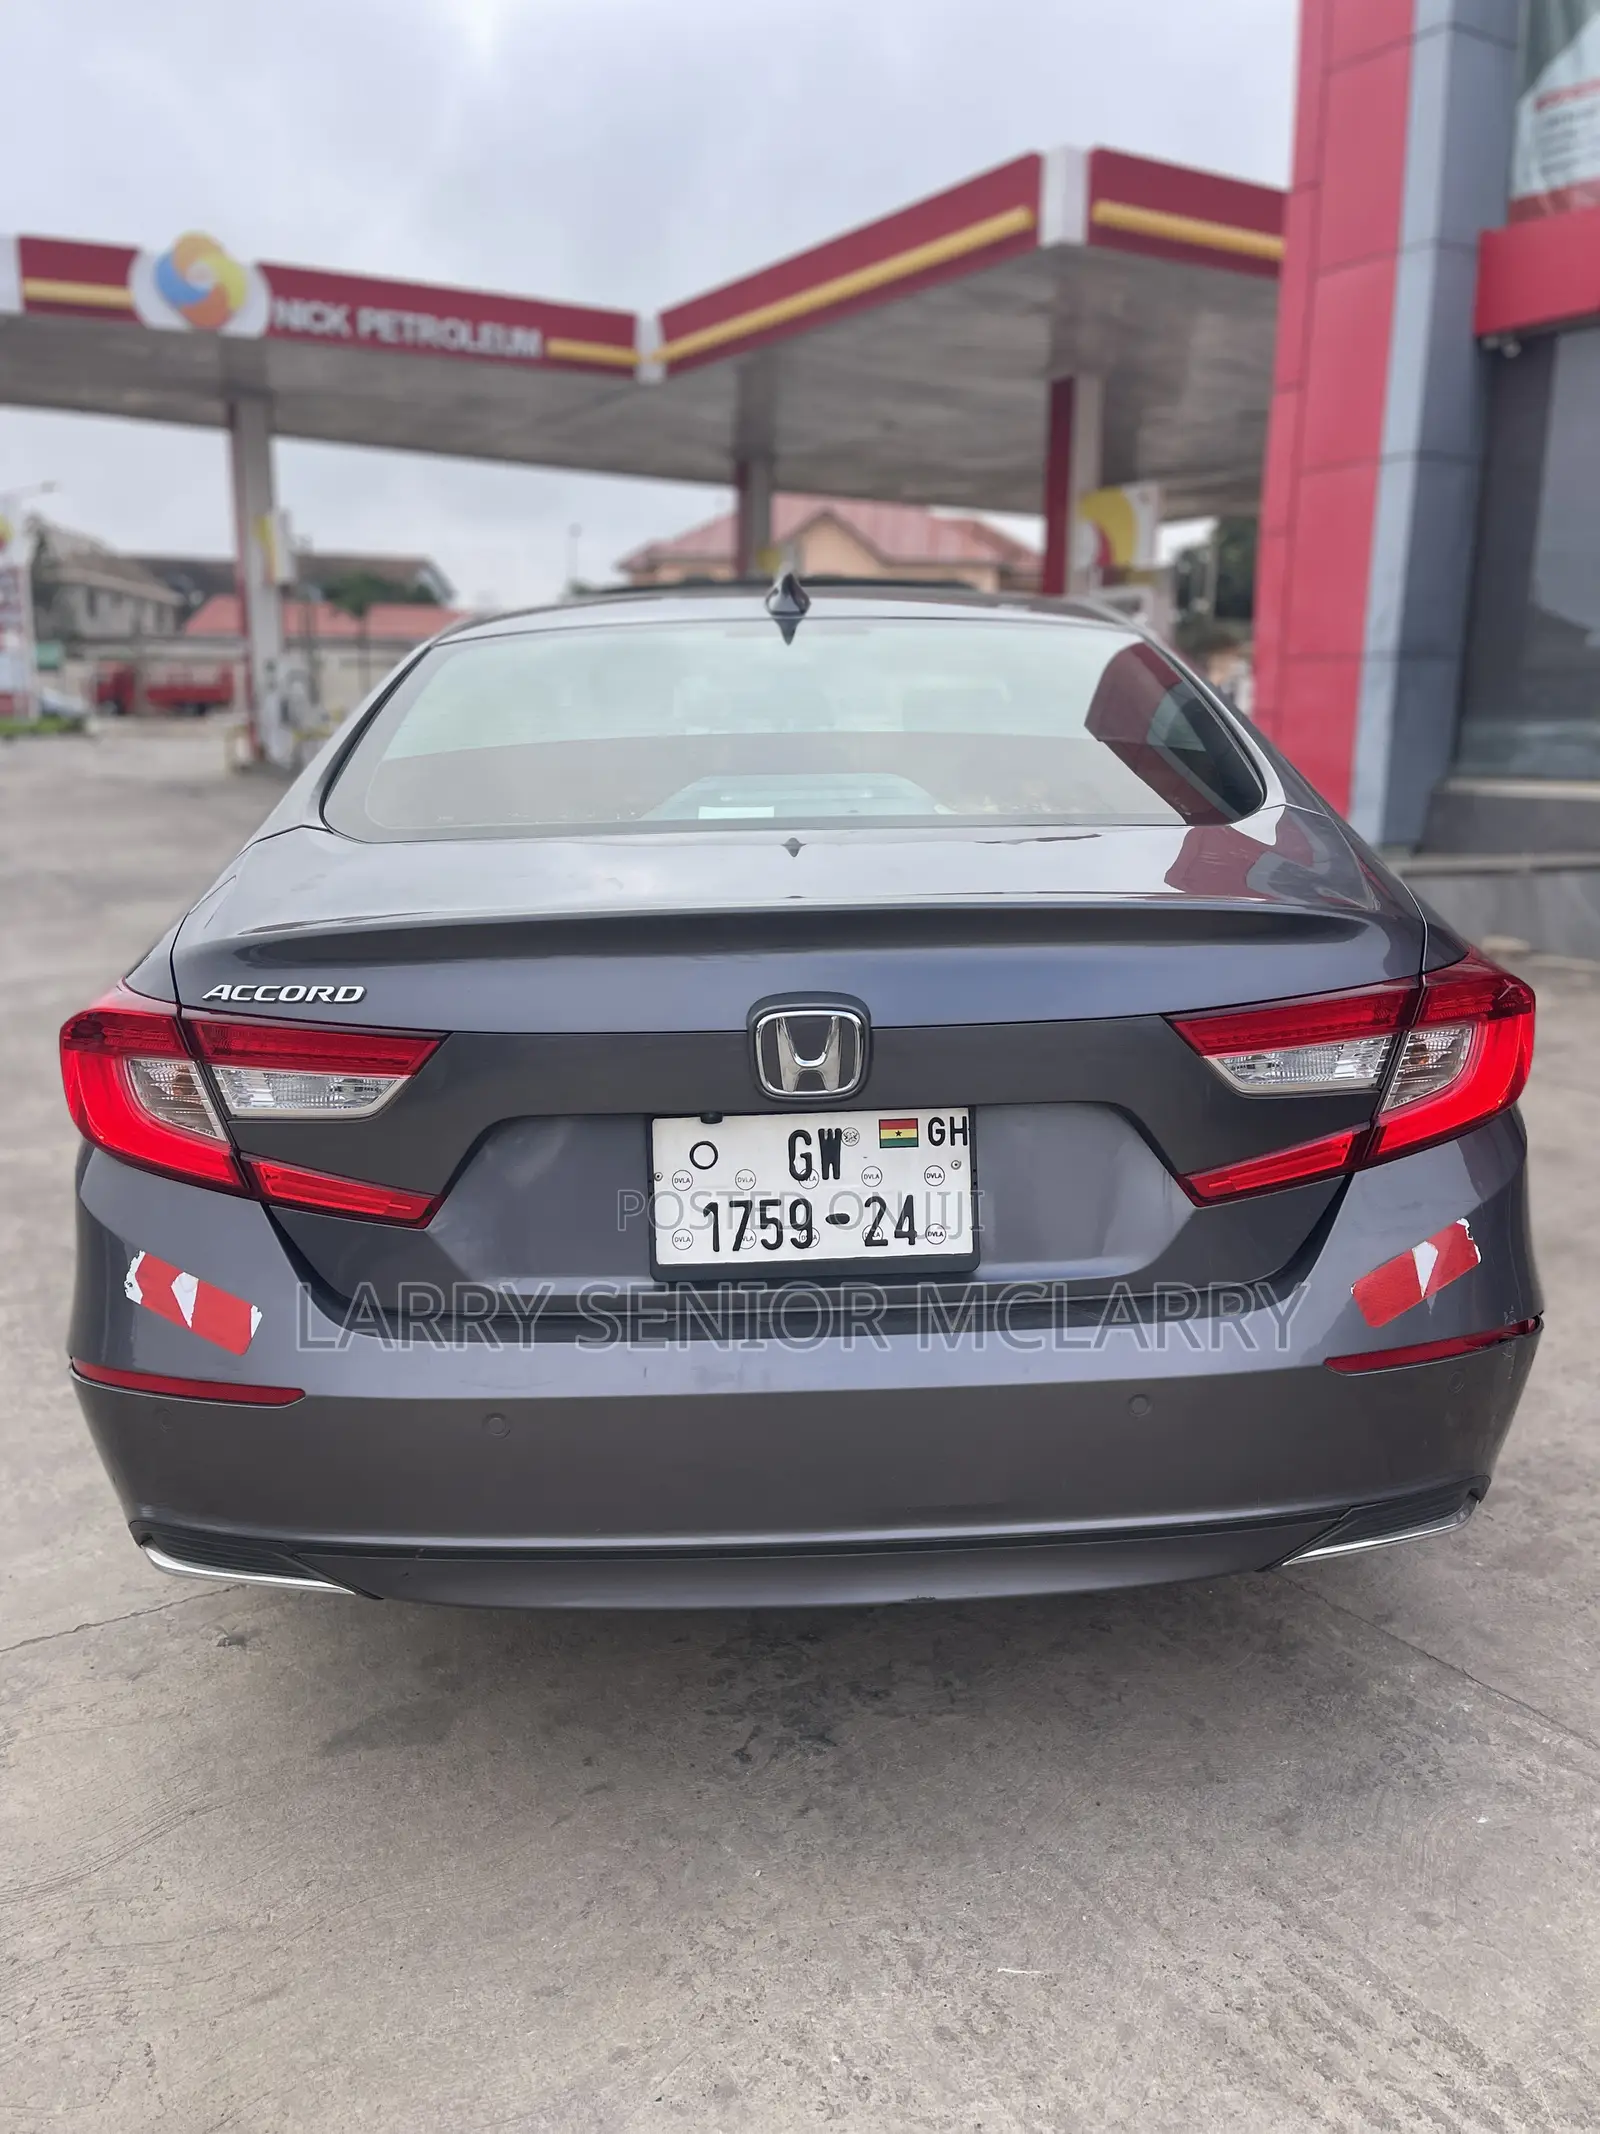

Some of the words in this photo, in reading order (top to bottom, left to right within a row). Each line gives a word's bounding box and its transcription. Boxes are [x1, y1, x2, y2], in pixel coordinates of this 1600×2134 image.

[356, 306, 543, 358] PETROLEUM
[202, 983, 367, 1004] ACCORD
[927, 1116, 967, 1146] GH
[788, 1128, 842, 1181] GW
[674, 1174, 691, 1183] DVLA
[737, 1174, 754, 1183] DVLA
